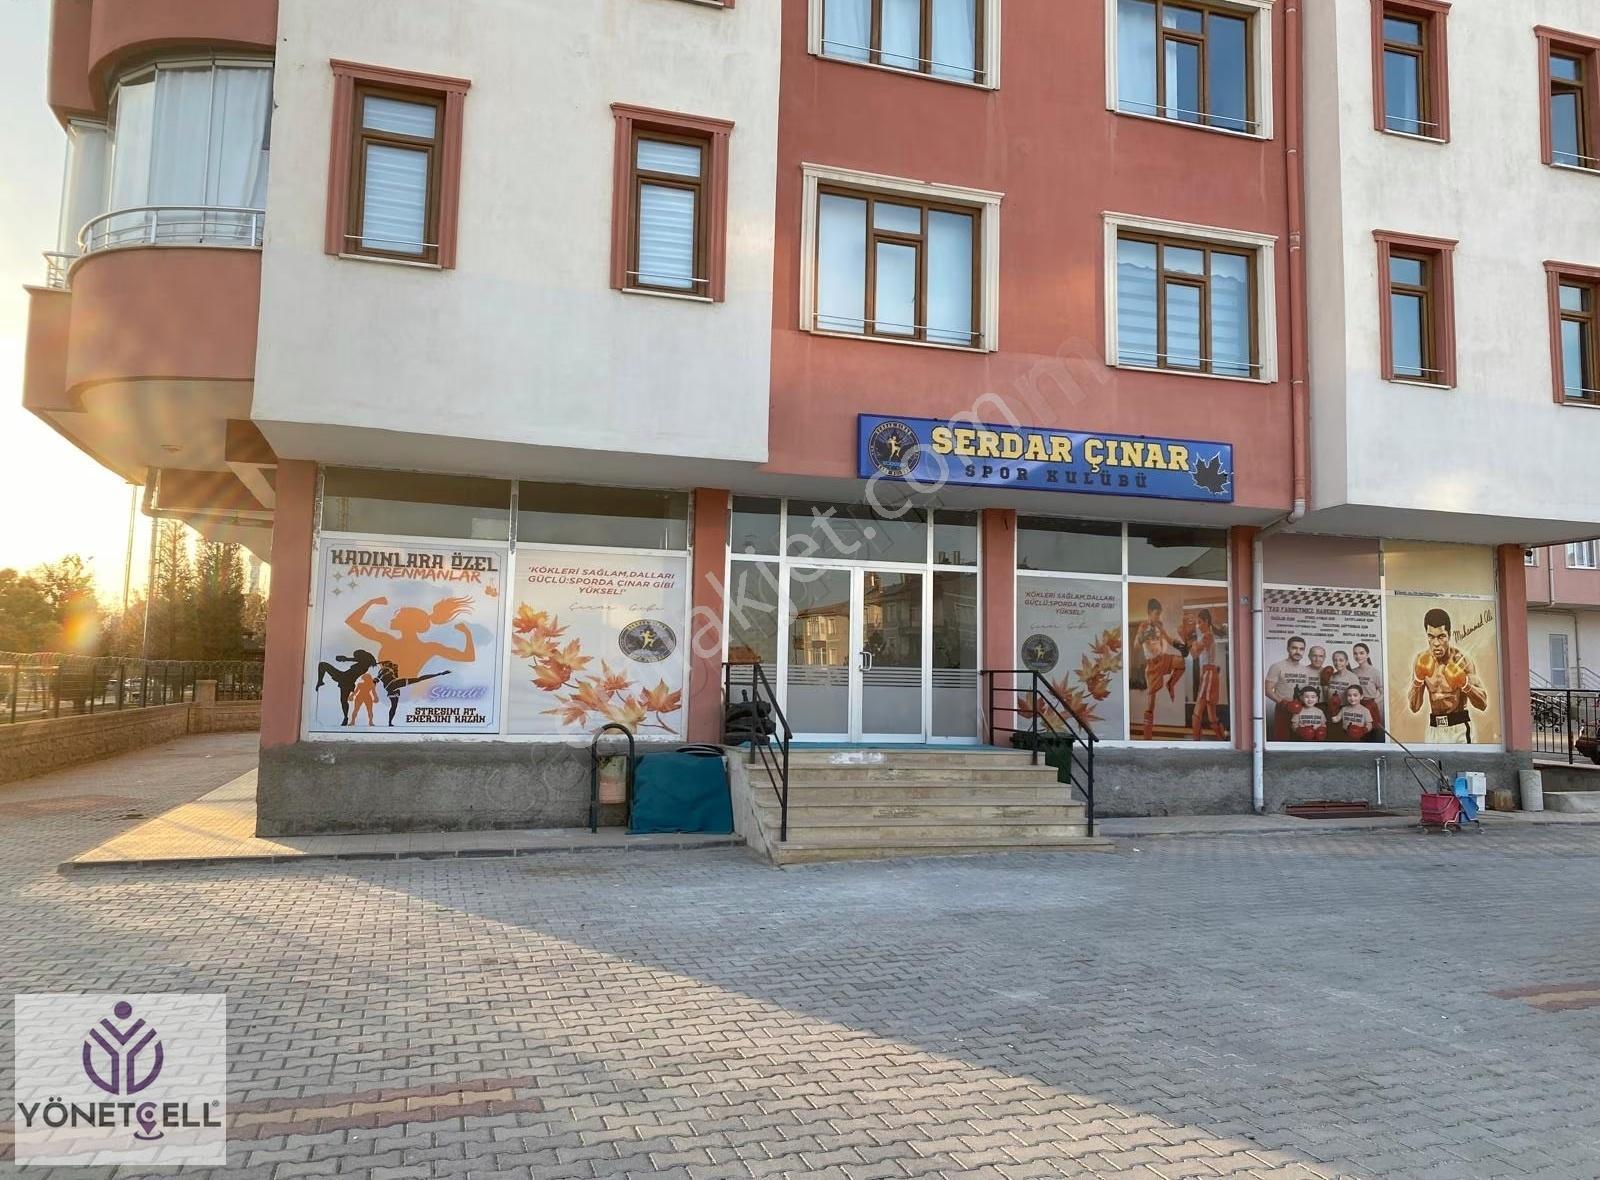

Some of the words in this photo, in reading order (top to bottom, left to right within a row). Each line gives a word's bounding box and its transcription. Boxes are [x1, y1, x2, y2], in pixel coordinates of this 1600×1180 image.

[930, 425, 1073, 464] SERDAR
[1084, 438, 1189, 473] ÇINAR
[965, 465, 1030, 481] SPOR
[1046, 467, 1148, 488] KULÜBÜ
[330, 549, 444, 569] KADINLARA
[451, 552, 499, 572] ÖZEL
[347, 565, 482, 584] ANTRENMANLAR
